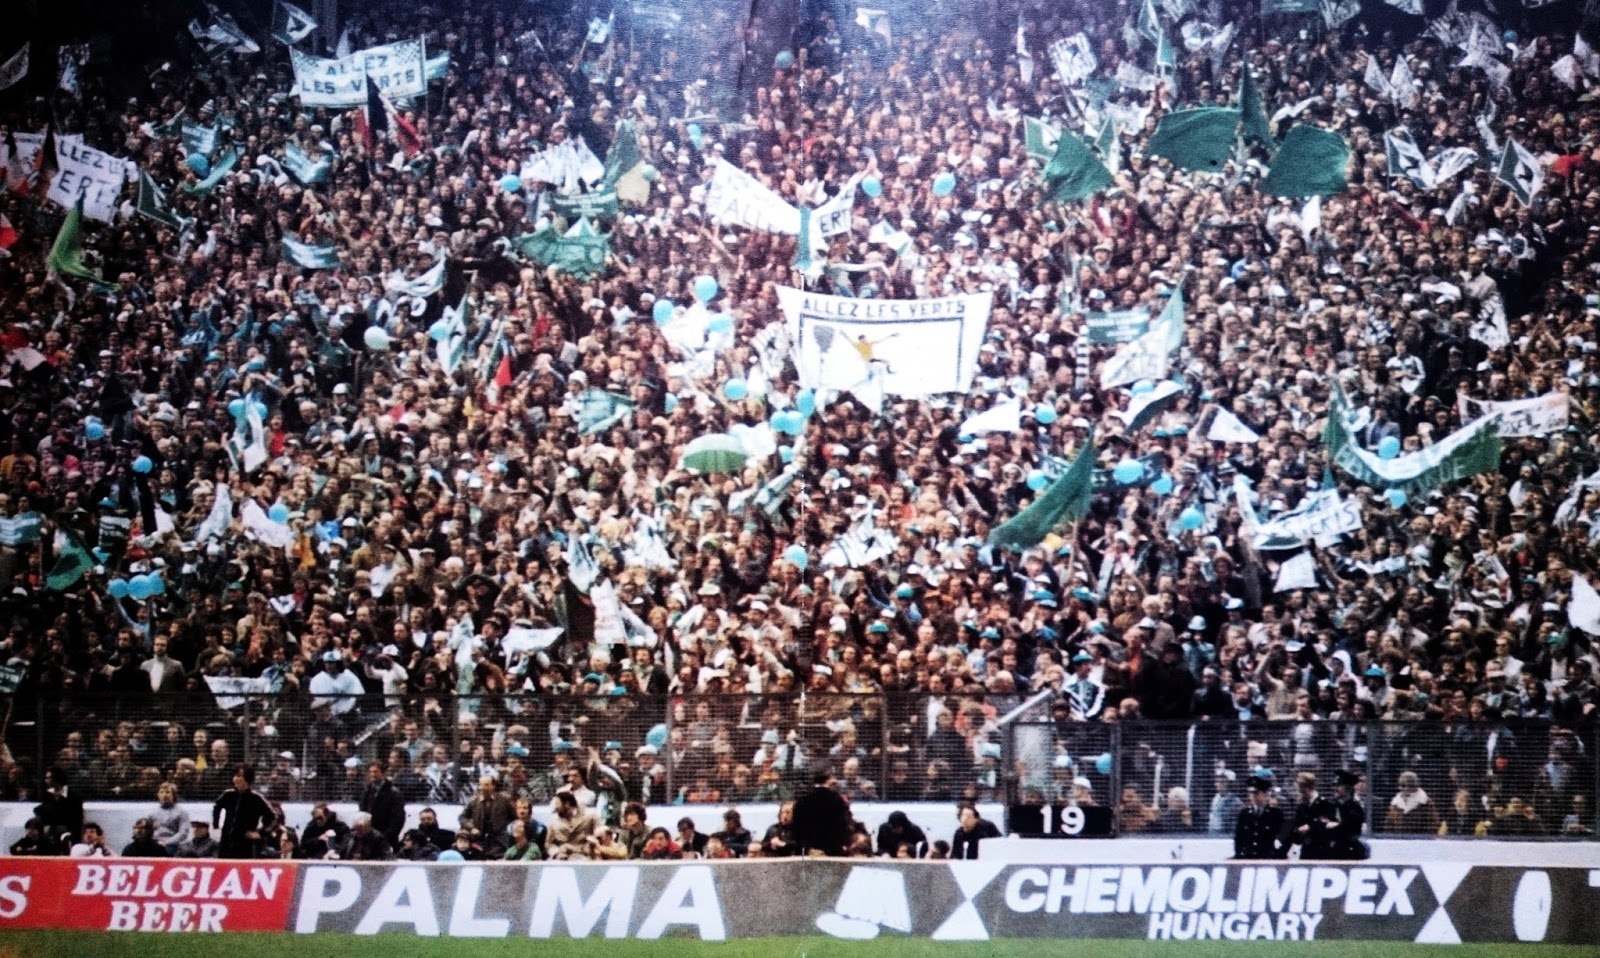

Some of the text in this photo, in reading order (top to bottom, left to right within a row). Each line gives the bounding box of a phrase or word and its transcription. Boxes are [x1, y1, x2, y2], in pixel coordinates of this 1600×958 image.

[301, 69, 415, 94] LES VRTS
[59, 139, 105, 168] LLEZ
[819, 208, 850, 234] ERT
[803, 297, 966, 317] ALLEZ LES VERTS
[1040, 805, 1086, 836] 19
[71, 863, 283, 900] BELGIAN
[1005, 866, 1420, 916] CHEMOLIMPEX
[107, 900, 229, 932] BEER
[295, 865, 726, 941] PALMA
[1147, 911, 1324, 942] HUNGARY
